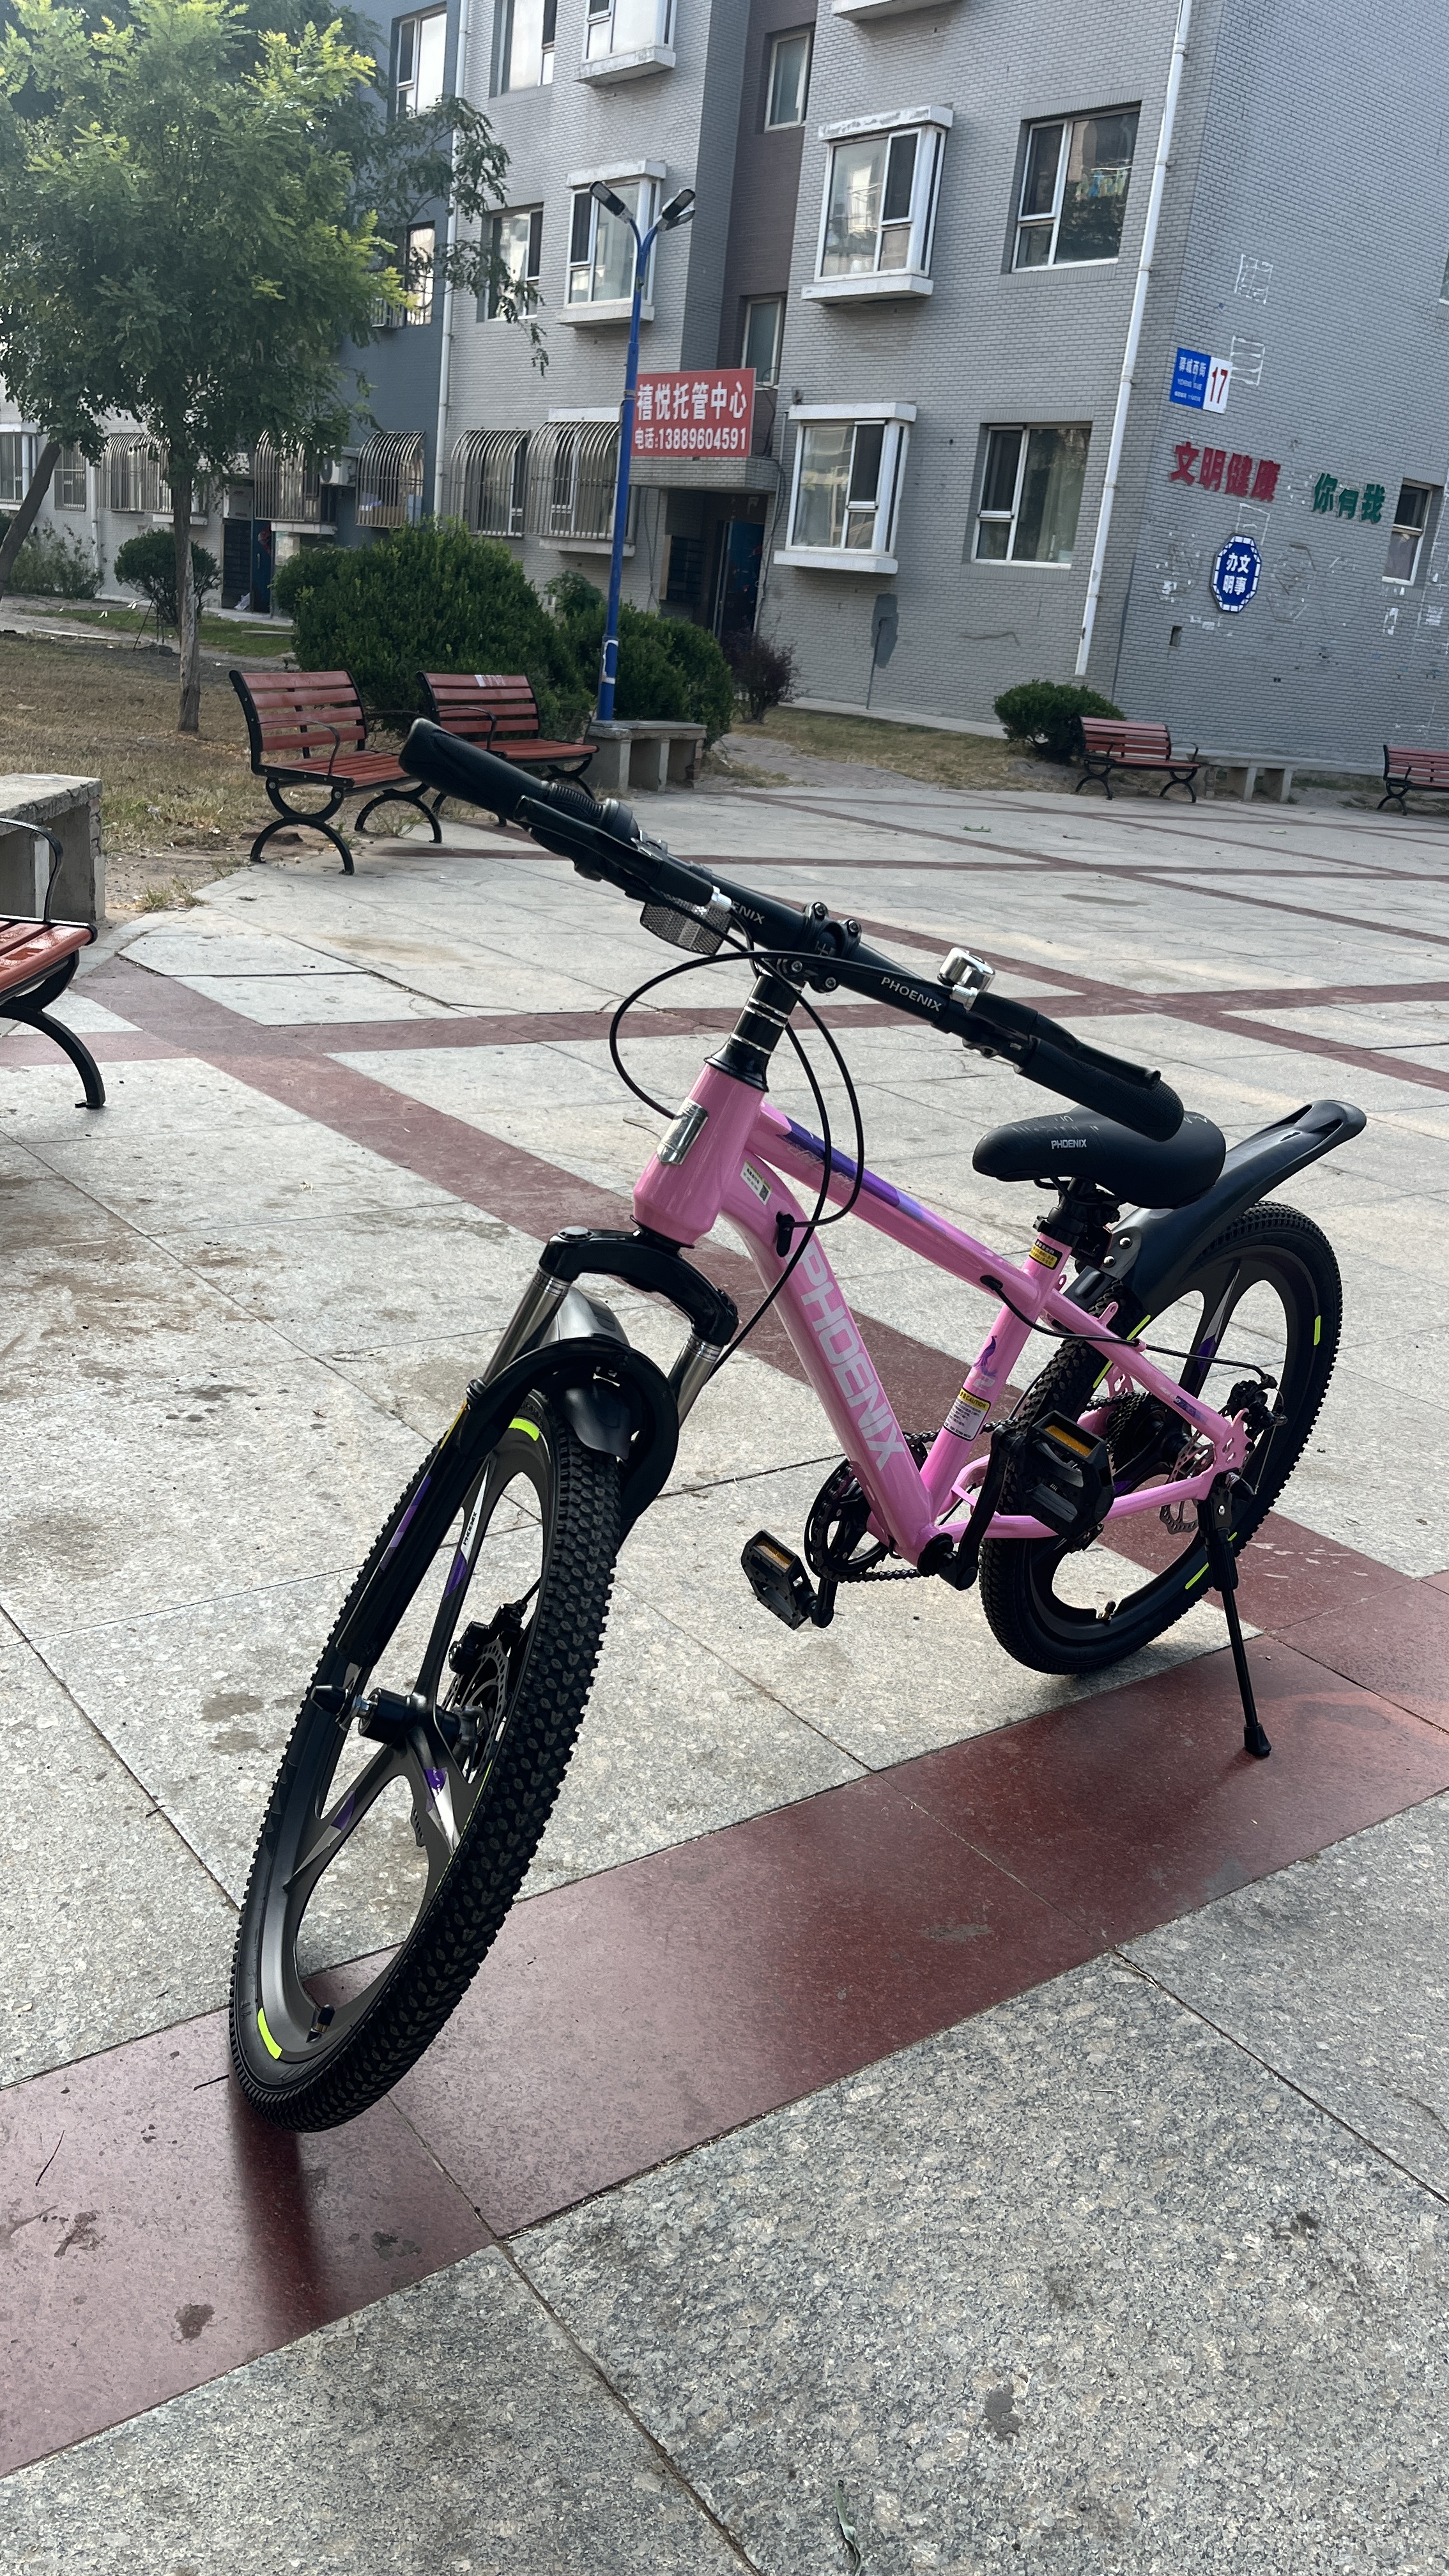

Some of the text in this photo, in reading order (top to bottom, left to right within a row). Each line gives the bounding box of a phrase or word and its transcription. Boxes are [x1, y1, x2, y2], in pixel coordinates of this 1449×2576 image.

[636, 381, 747, 421] 禧悦托管中心
[1209, 367, 1228, 404] 17
[634, 426, 746, 450] 电话:13889604591
[1170, 441, 1282, 503] 文明健康
[1313, 473, 1386, 523] 你有我
[880, 976, 942, 1012] PHOENIX
[1050, 1138, 1087, 1150] PHOENIX
[785, 1239, 906, 1471] PHOENIX
